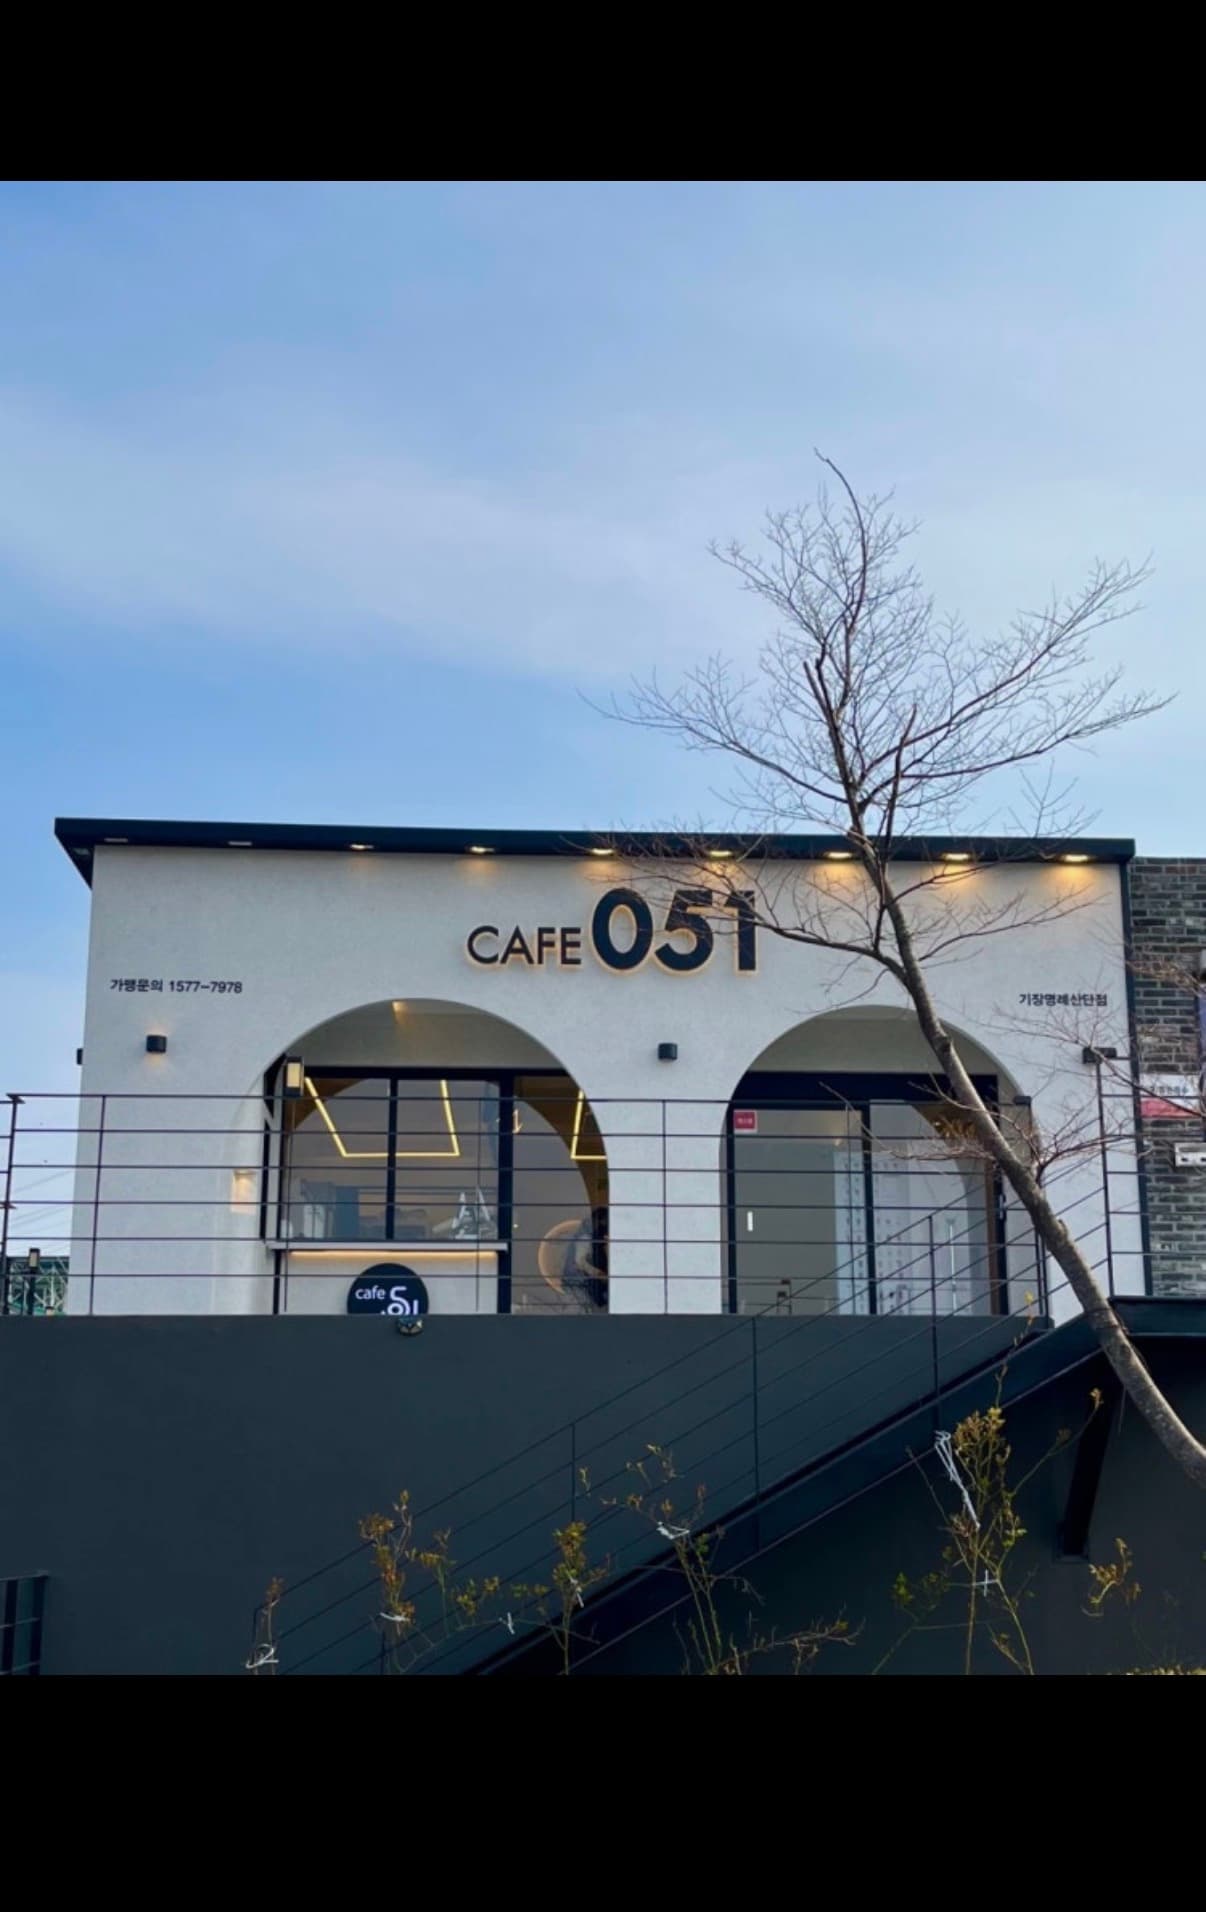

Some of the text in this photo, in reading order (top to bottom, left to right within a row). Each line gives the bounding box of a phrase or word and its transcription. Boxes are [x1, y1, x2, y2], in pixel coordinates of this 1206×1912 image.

[467, 888, 757, 971] CAFE 051
[110, 978, 243, 994] 가맹문의 1577-7978
[355, 1285, 386, 1300] cafe
